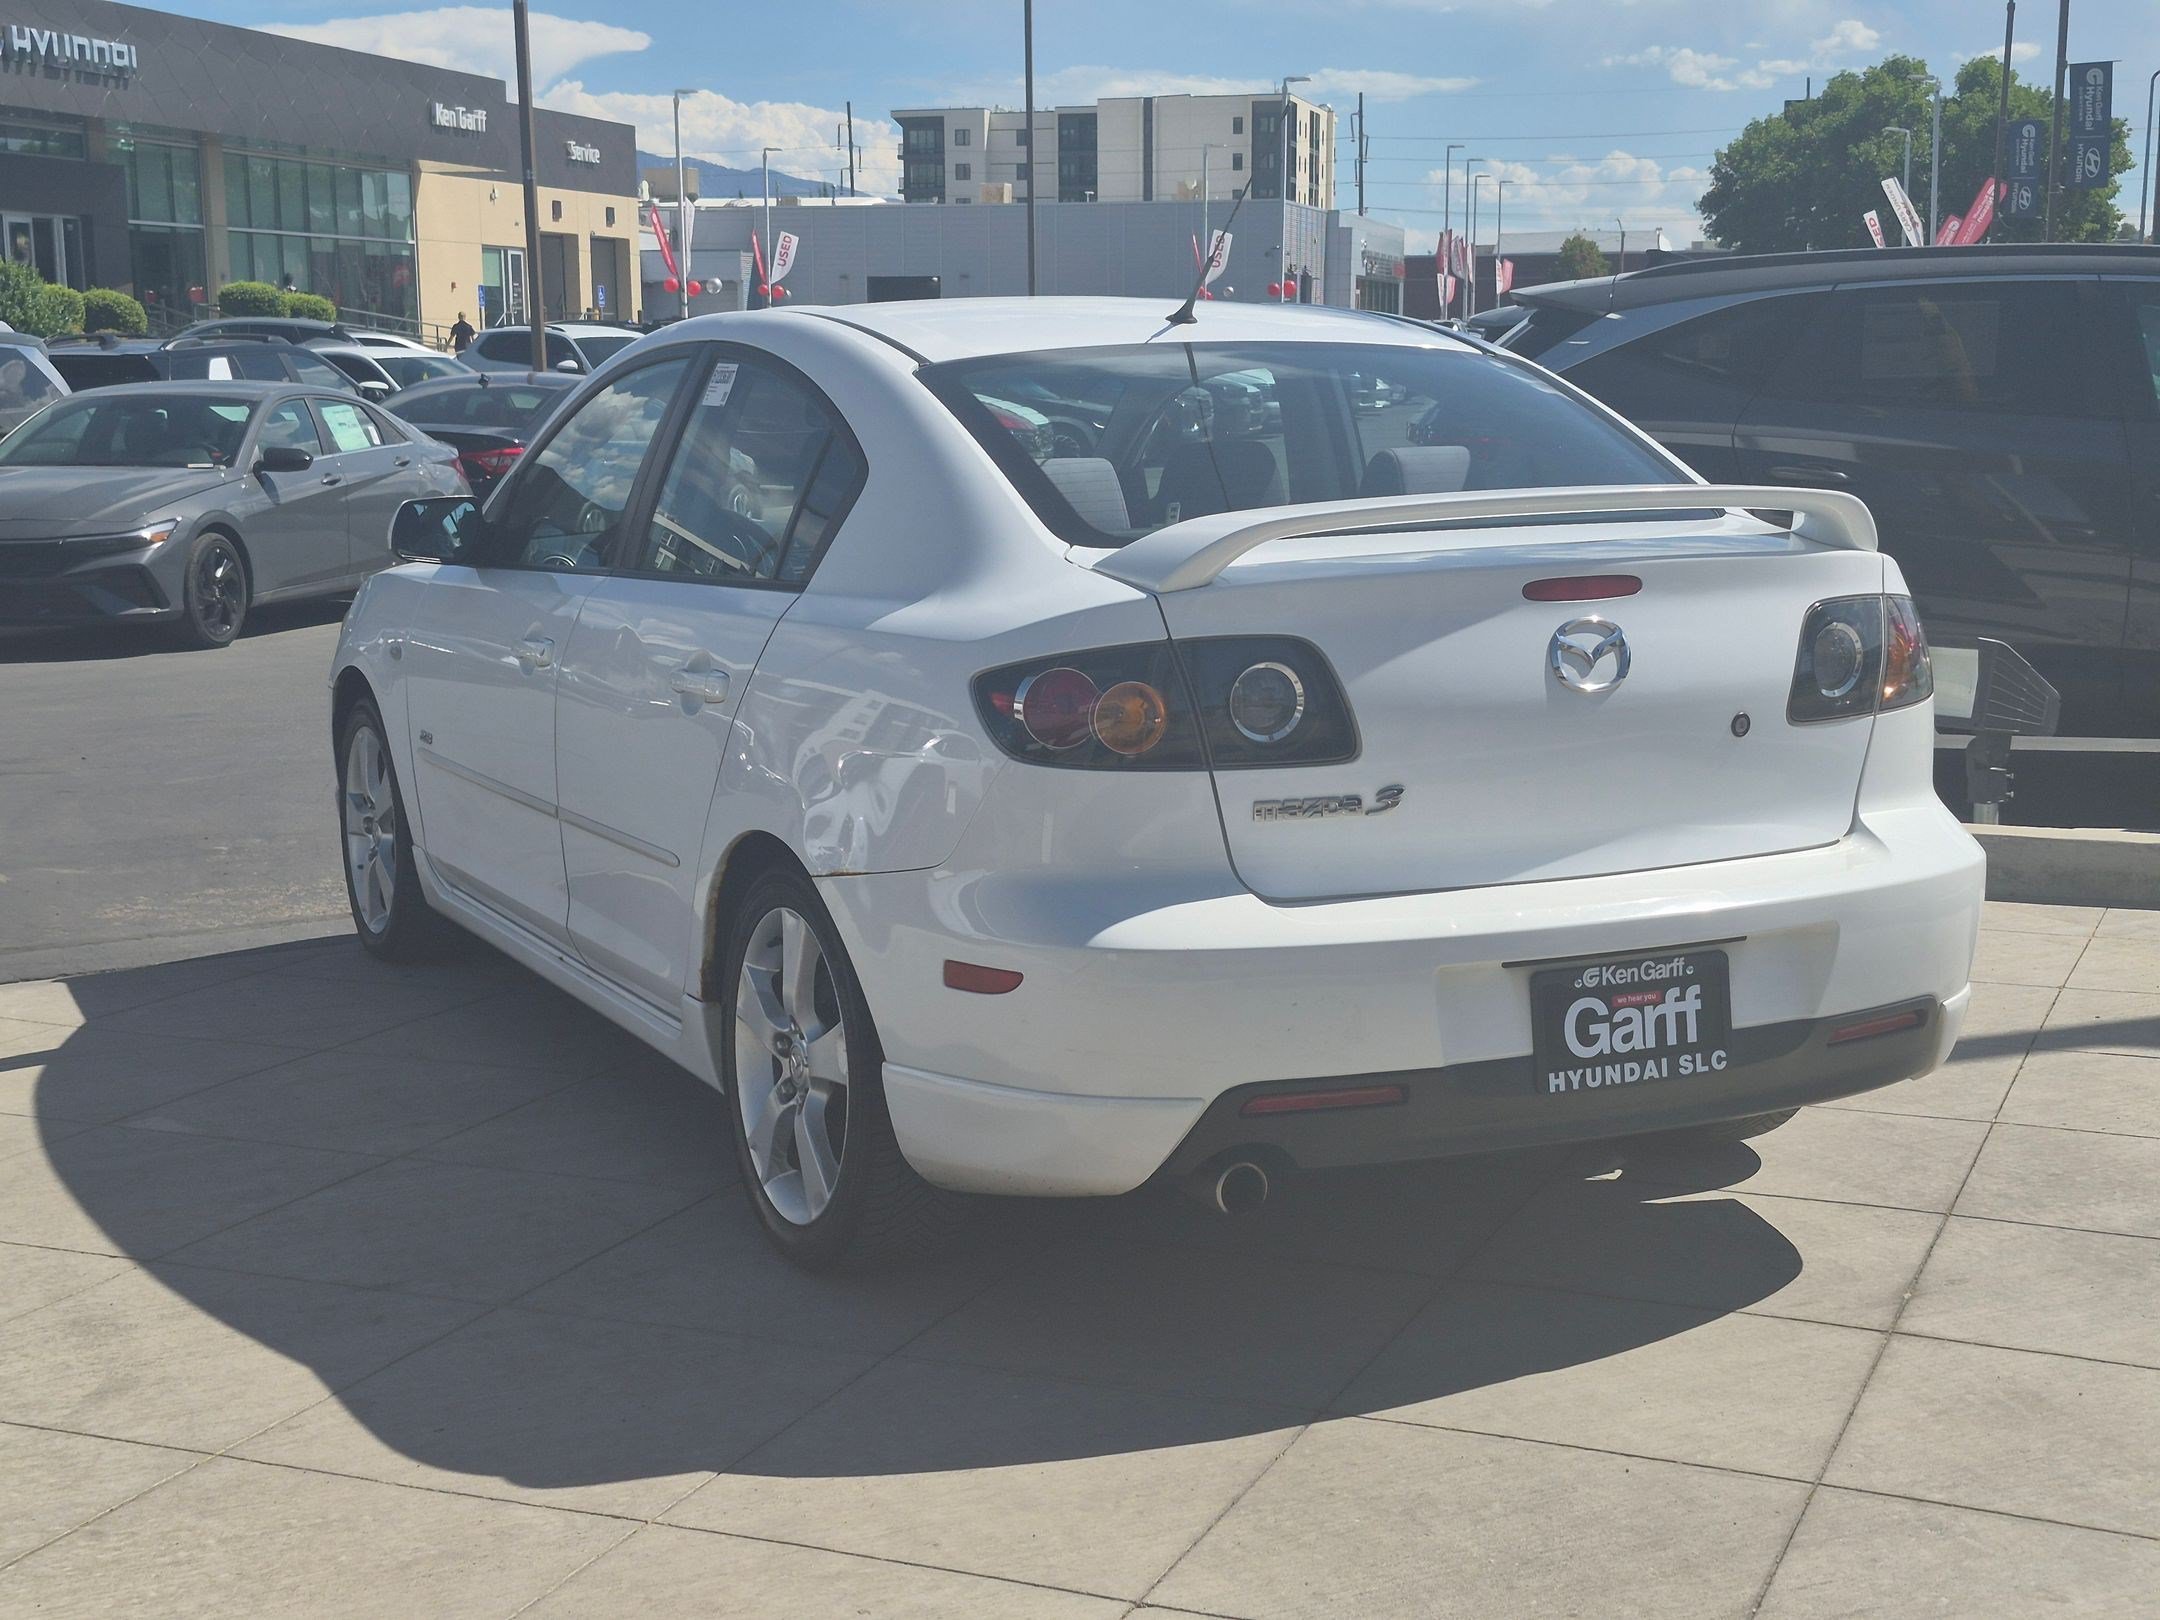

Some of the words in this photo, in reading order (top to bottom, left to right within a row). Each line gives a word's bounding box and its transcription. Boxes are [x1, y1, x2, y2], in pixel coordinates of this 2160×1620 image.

[11, 24, 138, 69] HYUNDAI
[434, 102, 457, 128] Ken
[456, 106, 487, 132] Garff
[567, 140, 600, 163] Service
[777, 235, 793, 267] USED
[1602, 964, 1639, 986] Ken
[1640, 957, 1685, 981] Garff
[1617, 995, 1627, 1003] we
[1628, 993, 1643, 1003] hear
[1644, 992, 1657, 1001] you
[1564, 984, 1702, 1059] Garff
[1548, 1057, 1668, 1093] HYUNDAI
[1679, 1049, 1728, 1075] SLC
